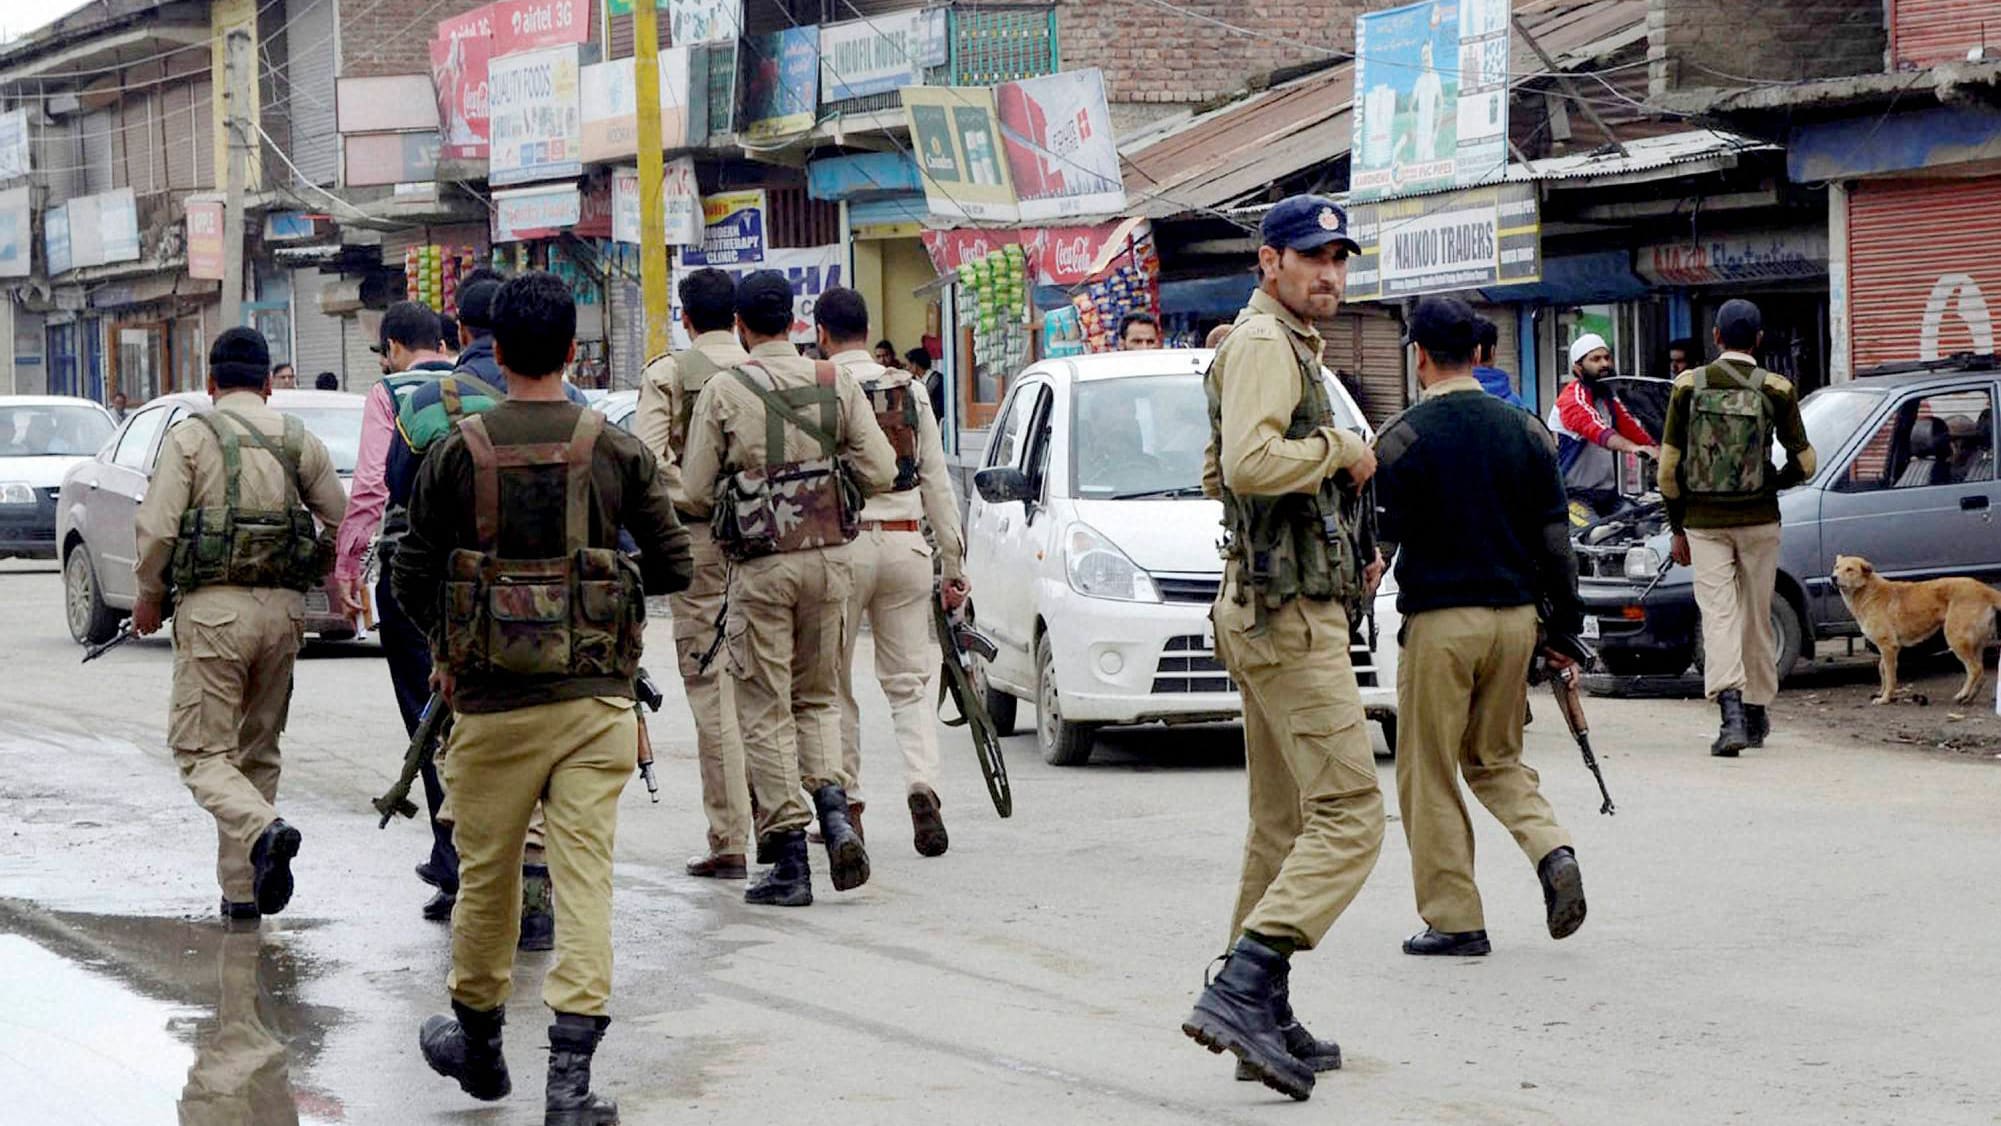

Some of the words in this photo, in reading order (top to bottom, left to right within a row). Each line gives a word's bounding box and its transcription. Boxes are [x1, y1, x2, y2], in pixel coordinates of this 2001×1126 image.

[523, 4, 552, 33] airtel
[556, 1, 573, 28] 3G
[522, 62, 552, 100] FOODS
[1352, 18, 1366, 164] KAMDHENU
[706, 250, 739, 264] CLINIC
[1394, 227, 1438, 270] NAIKOO
[1440, 220, 1494, 265] TRADERS
